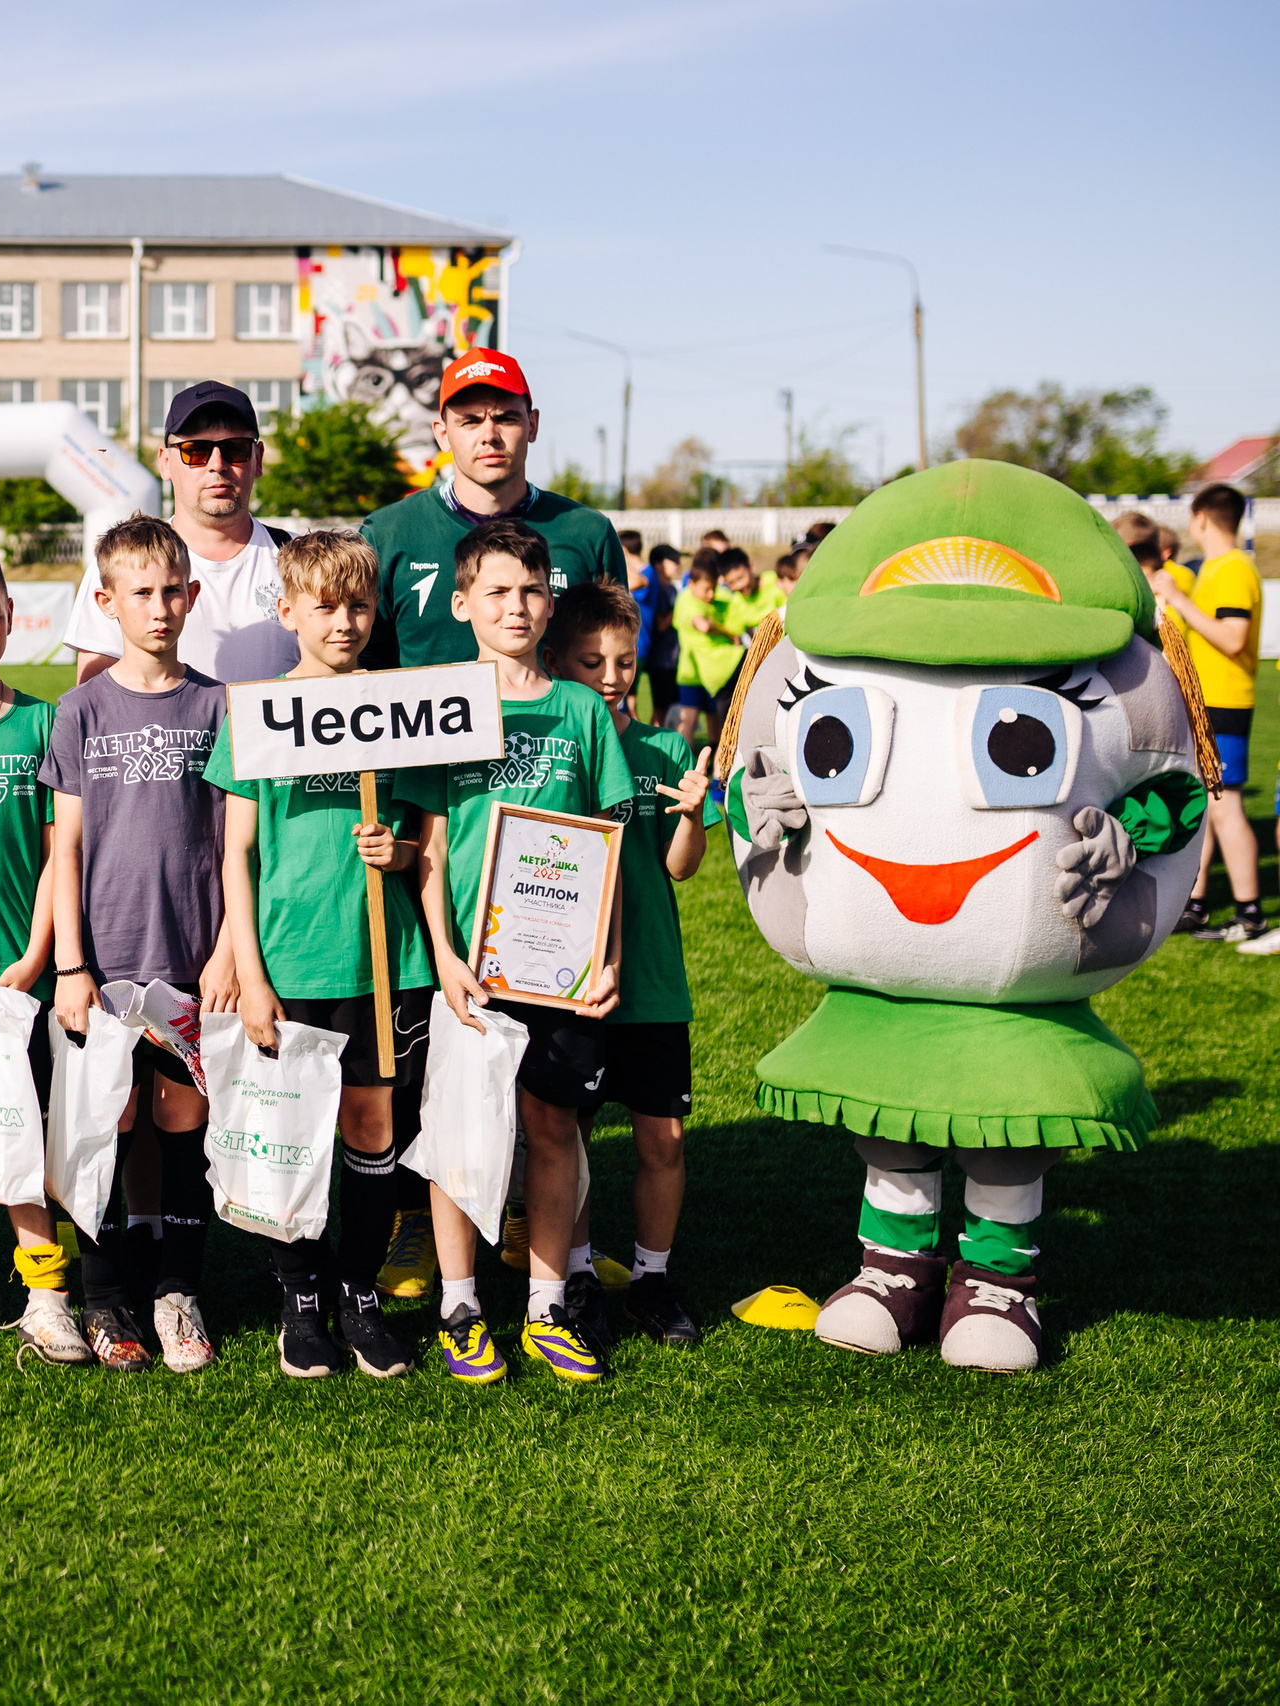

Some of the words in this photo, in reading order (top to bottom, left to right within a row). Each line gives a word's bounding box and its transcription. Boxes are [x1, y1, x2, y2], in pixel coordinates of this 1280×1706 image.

[409, 562, 440, 572] Первые
[261, 695, 474, 747] Чесма
[83, 723, 215, 760] МЕТРОШКА
[87, 766, 118, 775] ФЕСТИВАЛЬ
[92, 772, 119, 781] ДЕТСКОГО
[121, 751, 185, 785] 2025
[453, 772, 483, 781] ФЕСТИВАЛЬ
[487, 758, 552, 791] 2025
[305, 772, 361, 792] 202
[533, 865, 562, 881] 2025
[513, 881, 579, 903] ДИПЛОМ
[523, 897, 566, 910] УЧАСТНИКА
